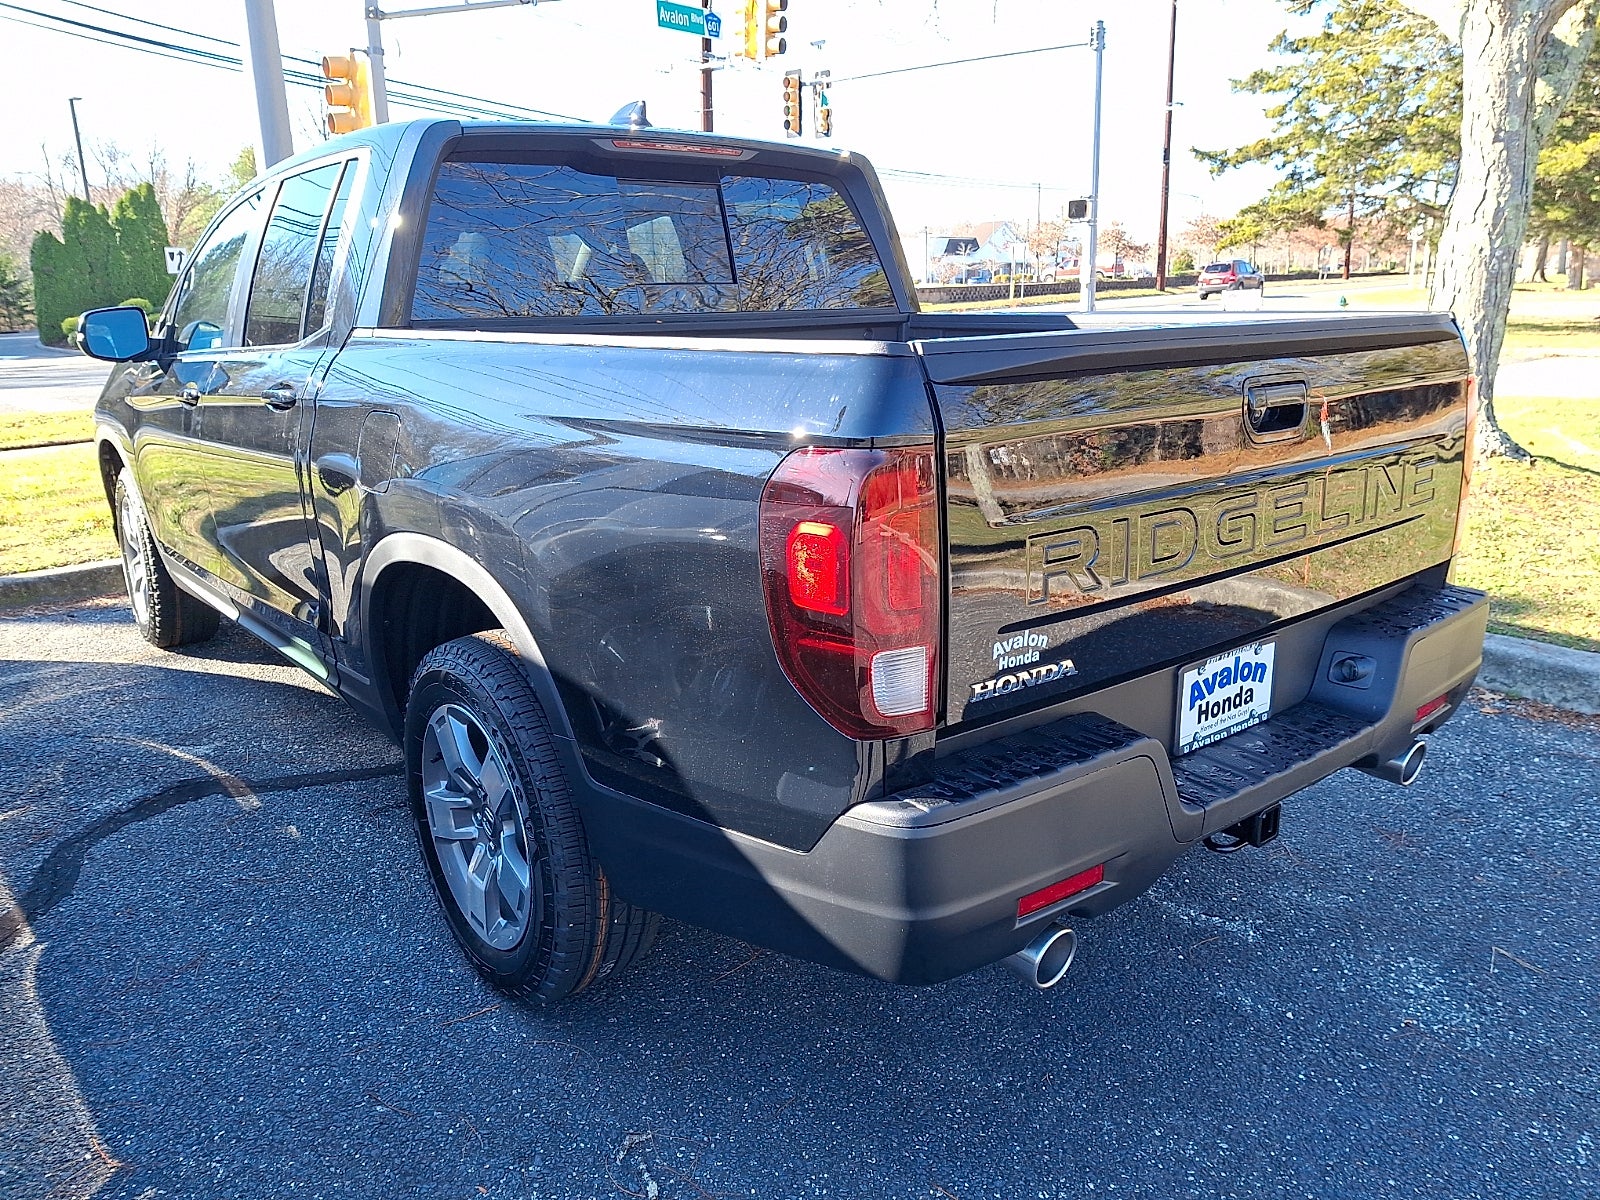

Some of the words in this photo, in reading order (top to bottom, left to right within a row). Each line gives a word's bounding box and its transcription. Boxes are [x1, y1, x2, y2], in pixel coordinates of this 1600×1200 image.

[660, 6, 690, 27] Avalon
[690, 12, 704, 25] Blvd
[707, 20, 720, 32] 601
[1025, 451, 1438, 607] RIDGELINE
[992, 629, 1049, 660] Avalon
[998, 648, 1040, 671] Honda
[969, 659, 1079, 702] HONDA
[1189, 656, 1268, 711] Avalon
[1197, 685, 1254, 725] Honda
[1191, 730, 1228, 750] Avalon
[1230, 716, 1260, 735] Honda
